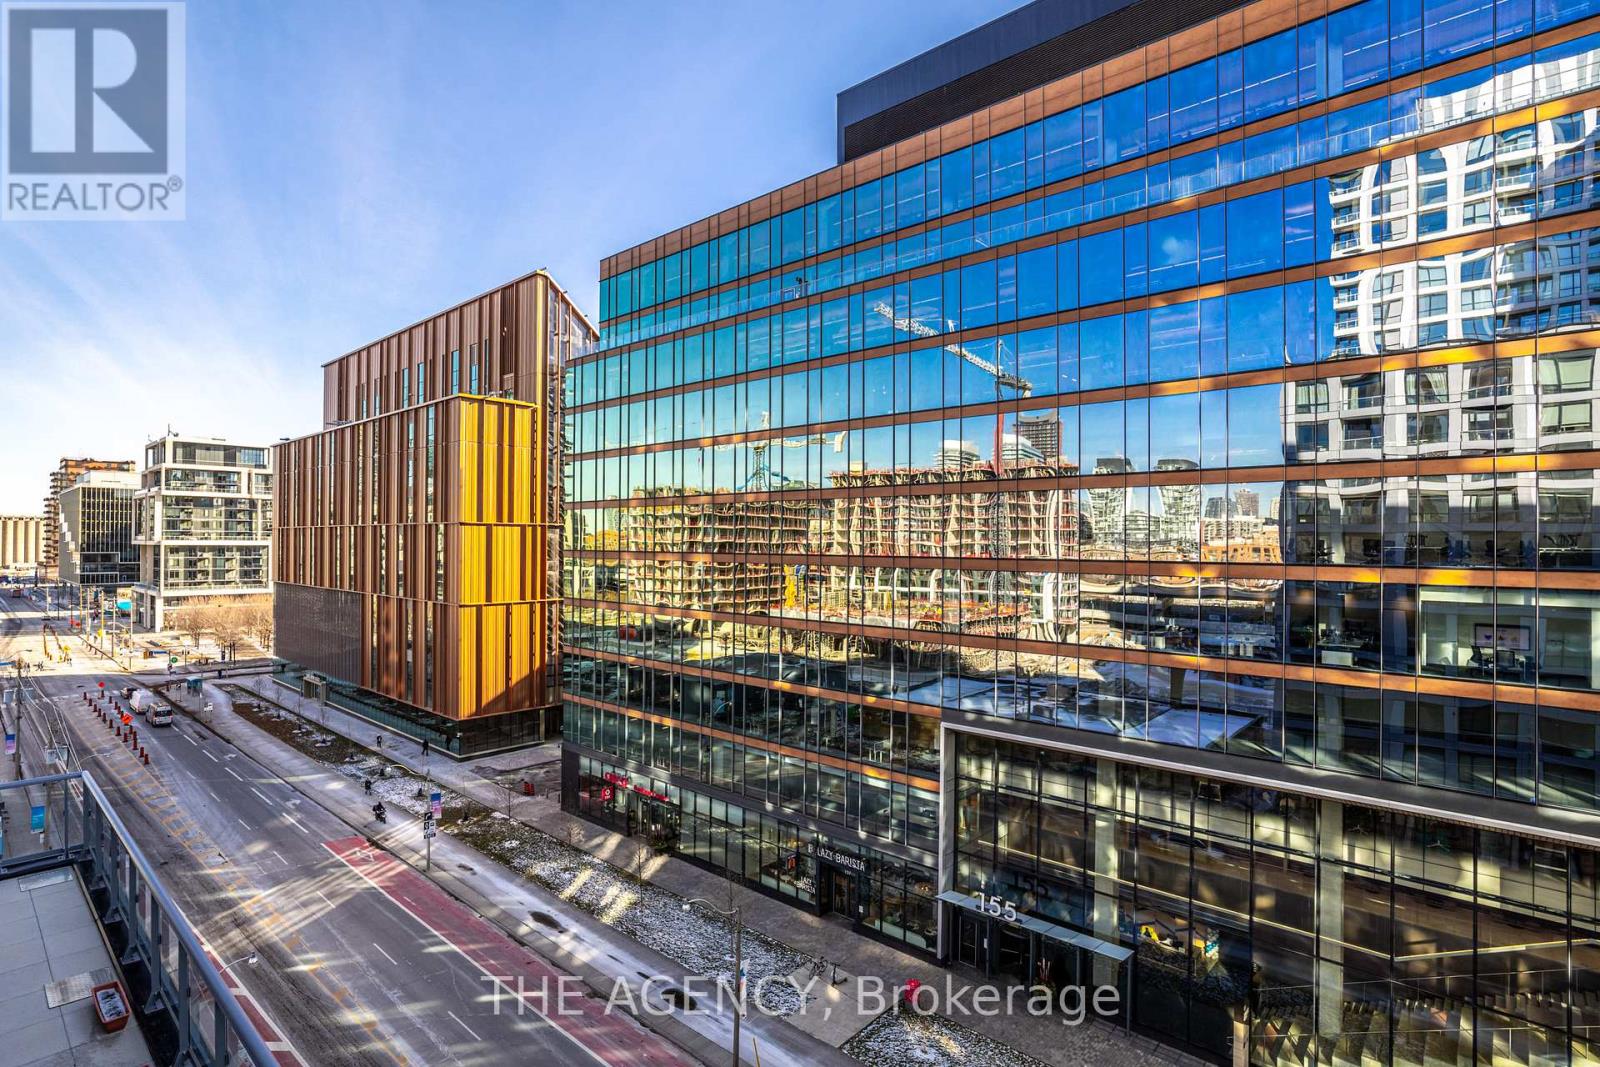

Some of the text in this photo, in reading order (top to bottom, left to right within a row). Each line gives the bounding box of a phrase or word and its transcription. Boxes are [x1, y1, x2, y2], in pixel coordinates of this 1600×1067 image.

[817, 847, 834, 861] LAZY
[835, 853, 866, 872] BARISTA
[979, 892, 1017, 921] 155
